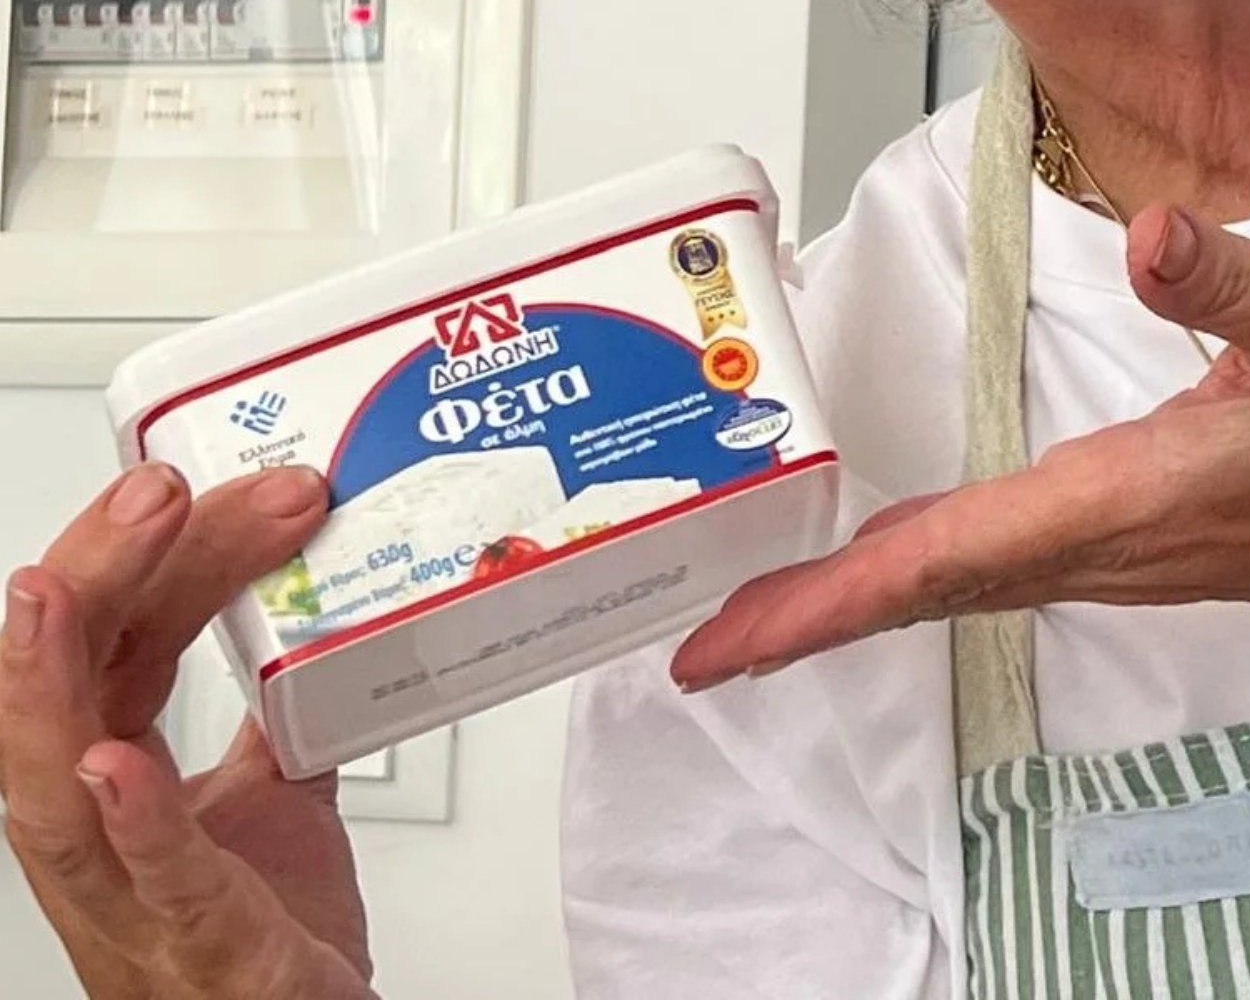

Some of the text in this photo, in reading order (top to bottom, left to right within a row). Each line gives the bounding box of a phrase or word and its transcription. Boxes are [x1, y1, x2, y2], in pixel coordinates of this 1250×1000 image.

[434, 331, 554, 390] ΔΩΔΩΝΗ
[419, 364, 591, 444] Φέτα
[367, 543, 413, 571] 630g
[411, 556, 456, 584] 400g
